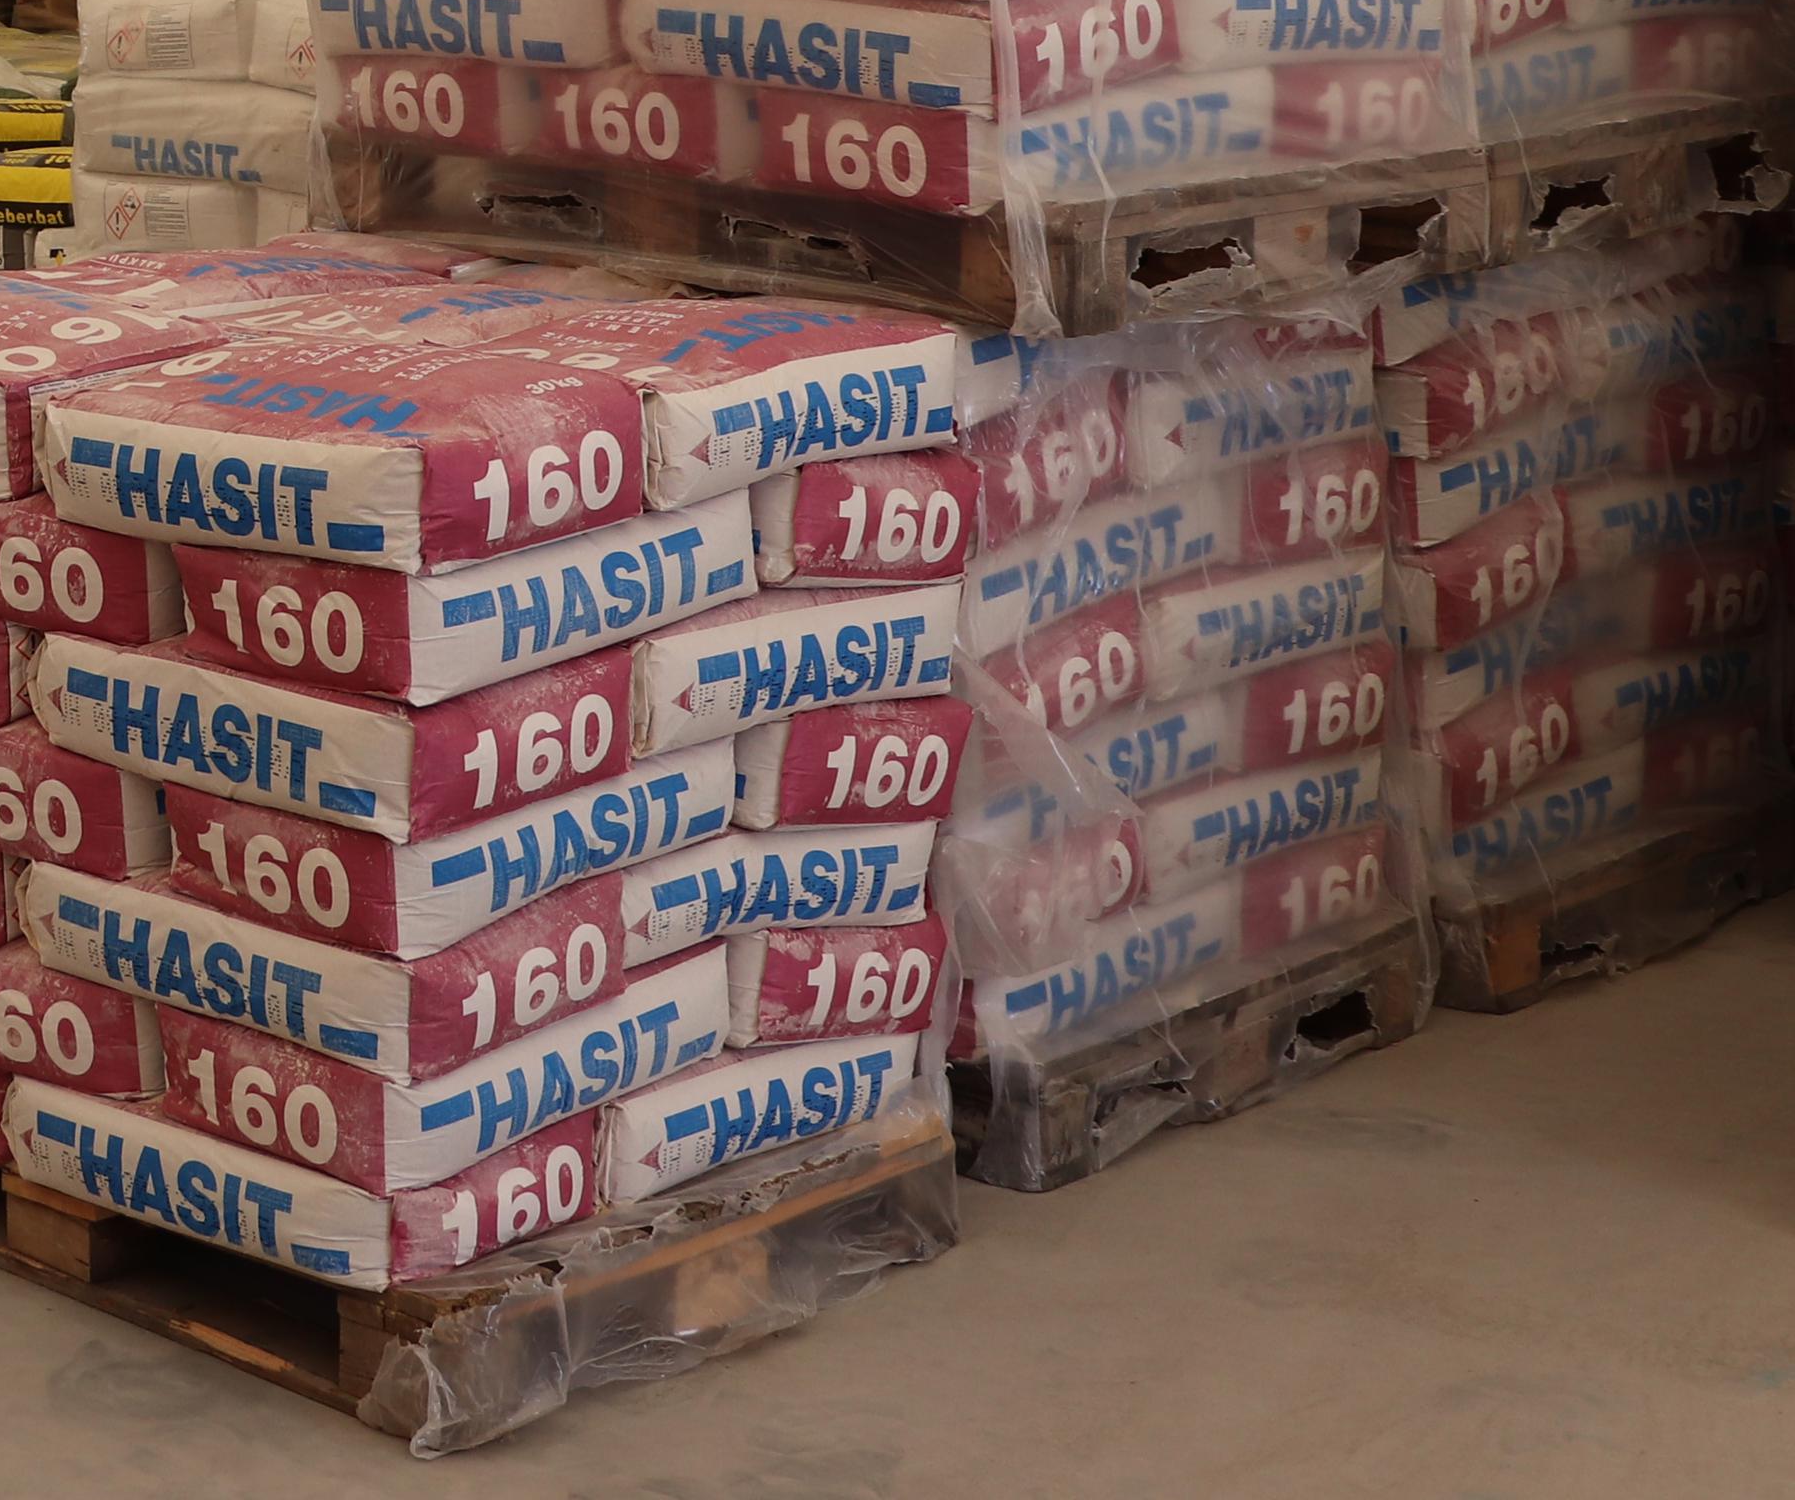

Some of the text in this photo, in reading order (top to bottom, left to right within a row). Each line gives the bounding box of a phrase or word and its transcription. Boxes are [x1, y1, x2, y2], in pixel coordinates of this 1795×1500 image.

[350, 67, 465, 137] 160
[700, 13, 910, 101] HASIT
[134, 136, 239, 179] HASIT
[555, 82, 679, 160] 160
[783, 113, 926, 197] 160
[217, 378, 417, 433] HASIT
[525, 374, 582, 397] 30kg
[755, 365, 926, 469] HASIT
[115, 442, 328, 546] HASIT
[474, 430, 623, 541] 160
[839, 485, 960, 563] 160
[1279, 468, 1380, 545] 160
[497, 527, 703, 664] HASIT
[1029, 504, 1183, 623] HASIT
[211, 578, 364, 674] 160
[738, 616, 926, 719] HASIT
[107, 672, 324, 802] HASIT
[464, 694, 613, 809] 160
[826, 734, 949, 809] 160
[481, 772, 689, 913] HASIT
[1224, 768, 1361, 867] HASIT
[198, 822, 350, 928] 160
[699, 845, 898, 937] HASIT
[104, 910, 322, 1040] HASIT
[462, 923, 607, 1048] 160
[807, 947, 931, 1026] 160
[188, 1049, 338, 1165] 160
[474, 1001, 681, 1153] HASIT
[708, 1050, 893, 1163] HASIT
[77, 1125, 293, 1258] HASIT
[443, 1144, 583, 1265] 160
